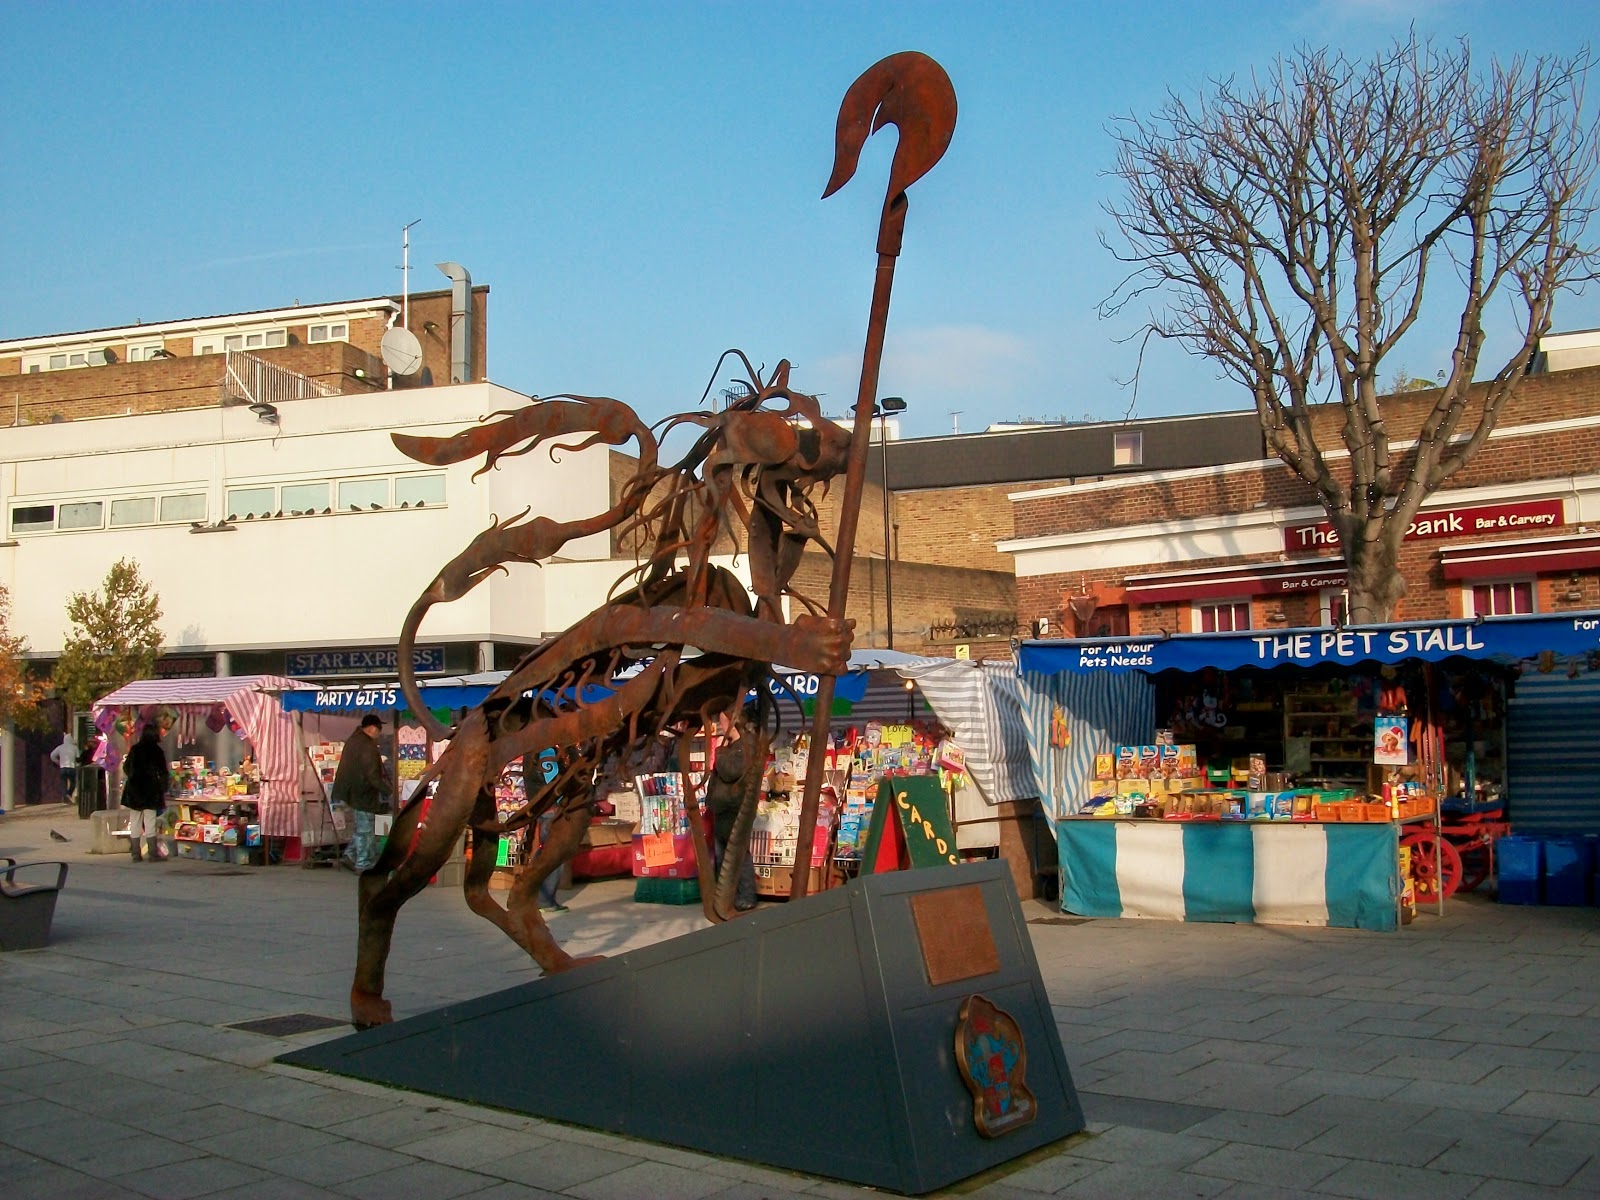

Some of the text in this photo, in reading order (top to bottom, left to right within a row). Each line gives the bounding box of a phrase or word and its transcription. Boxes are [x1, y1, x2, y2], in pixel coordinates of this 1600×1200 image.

[1295, 526, 1339, 546] The
[1475, 518, 1497, 529] Bar
[1497, 515, 1508, 527] &
[1508, 512, 1555, 527] Carvery
[1282, 577, 1348, 589] Bar & Carvery
[1105, 645, 1122, 655] All
[1126, 643, 1155, 654] Your
[1251, 625, 1485, 659] THE PET STALL
[296, 649, 433, 669] STAR EXPRSS
[1079, 653, 1154, 668] Pets Needs
[315, 689, 397, 706] PARTY GIFTS
[886, 725, 909, 733] TOYS
